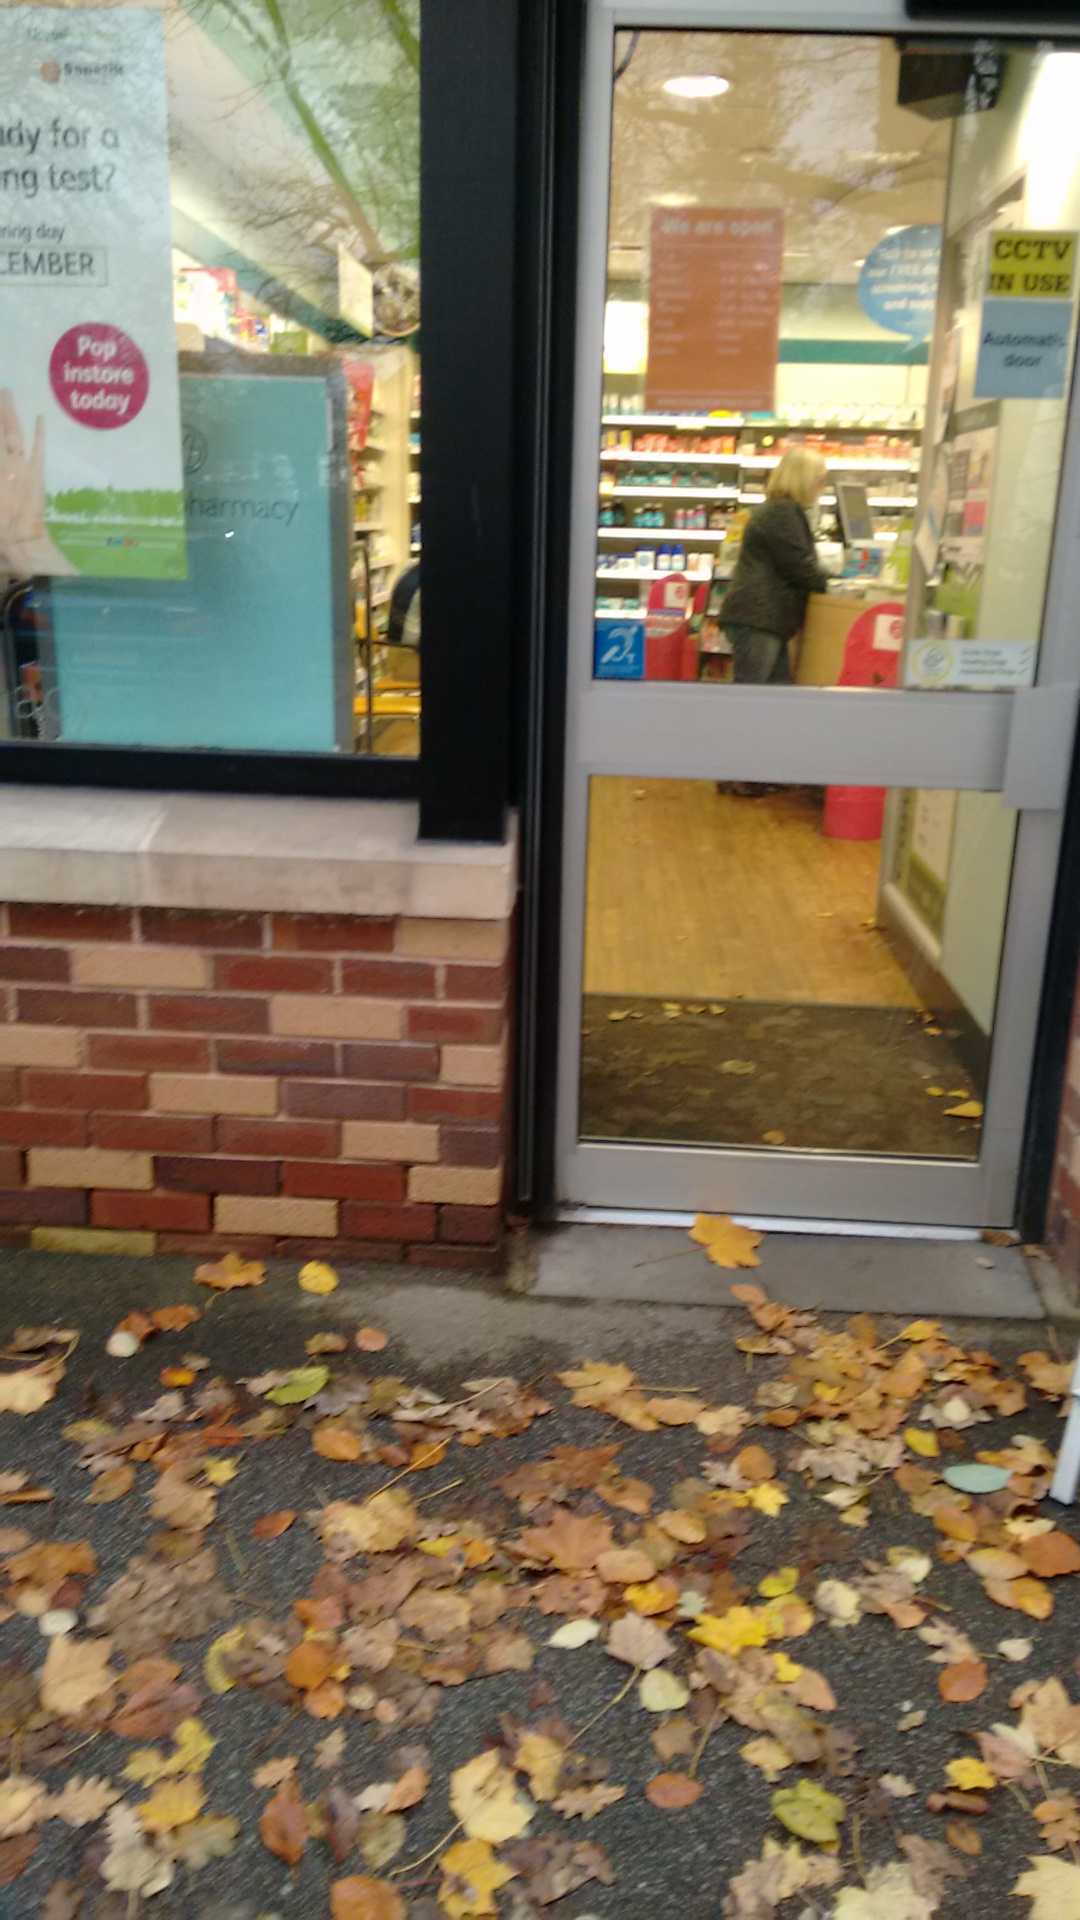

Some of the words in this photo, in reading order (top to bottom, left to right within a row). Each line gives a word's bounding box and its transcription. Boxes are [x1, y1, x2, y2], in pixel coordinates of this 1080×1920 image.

[50, 118, 91, 148] for
[101, 127, 120, 149] a
[48, 163, 117, 192] test?
[36, 222, 66, 244] day
[695, 220, 724, 236] are
[730, 220, 773, 238] open
[993, 239, 1071, 261] CCTV
[988, 273, 1014, 292] IN
[1022, 273, 1071, 292] USE
[76, 334, 118, 362] Pop
[1003, 353, 1043, 368] door
[63, 361, 135, 385] instore
[69, 388, 132, 416] today
[184, 490, 300, 527] harmacy
